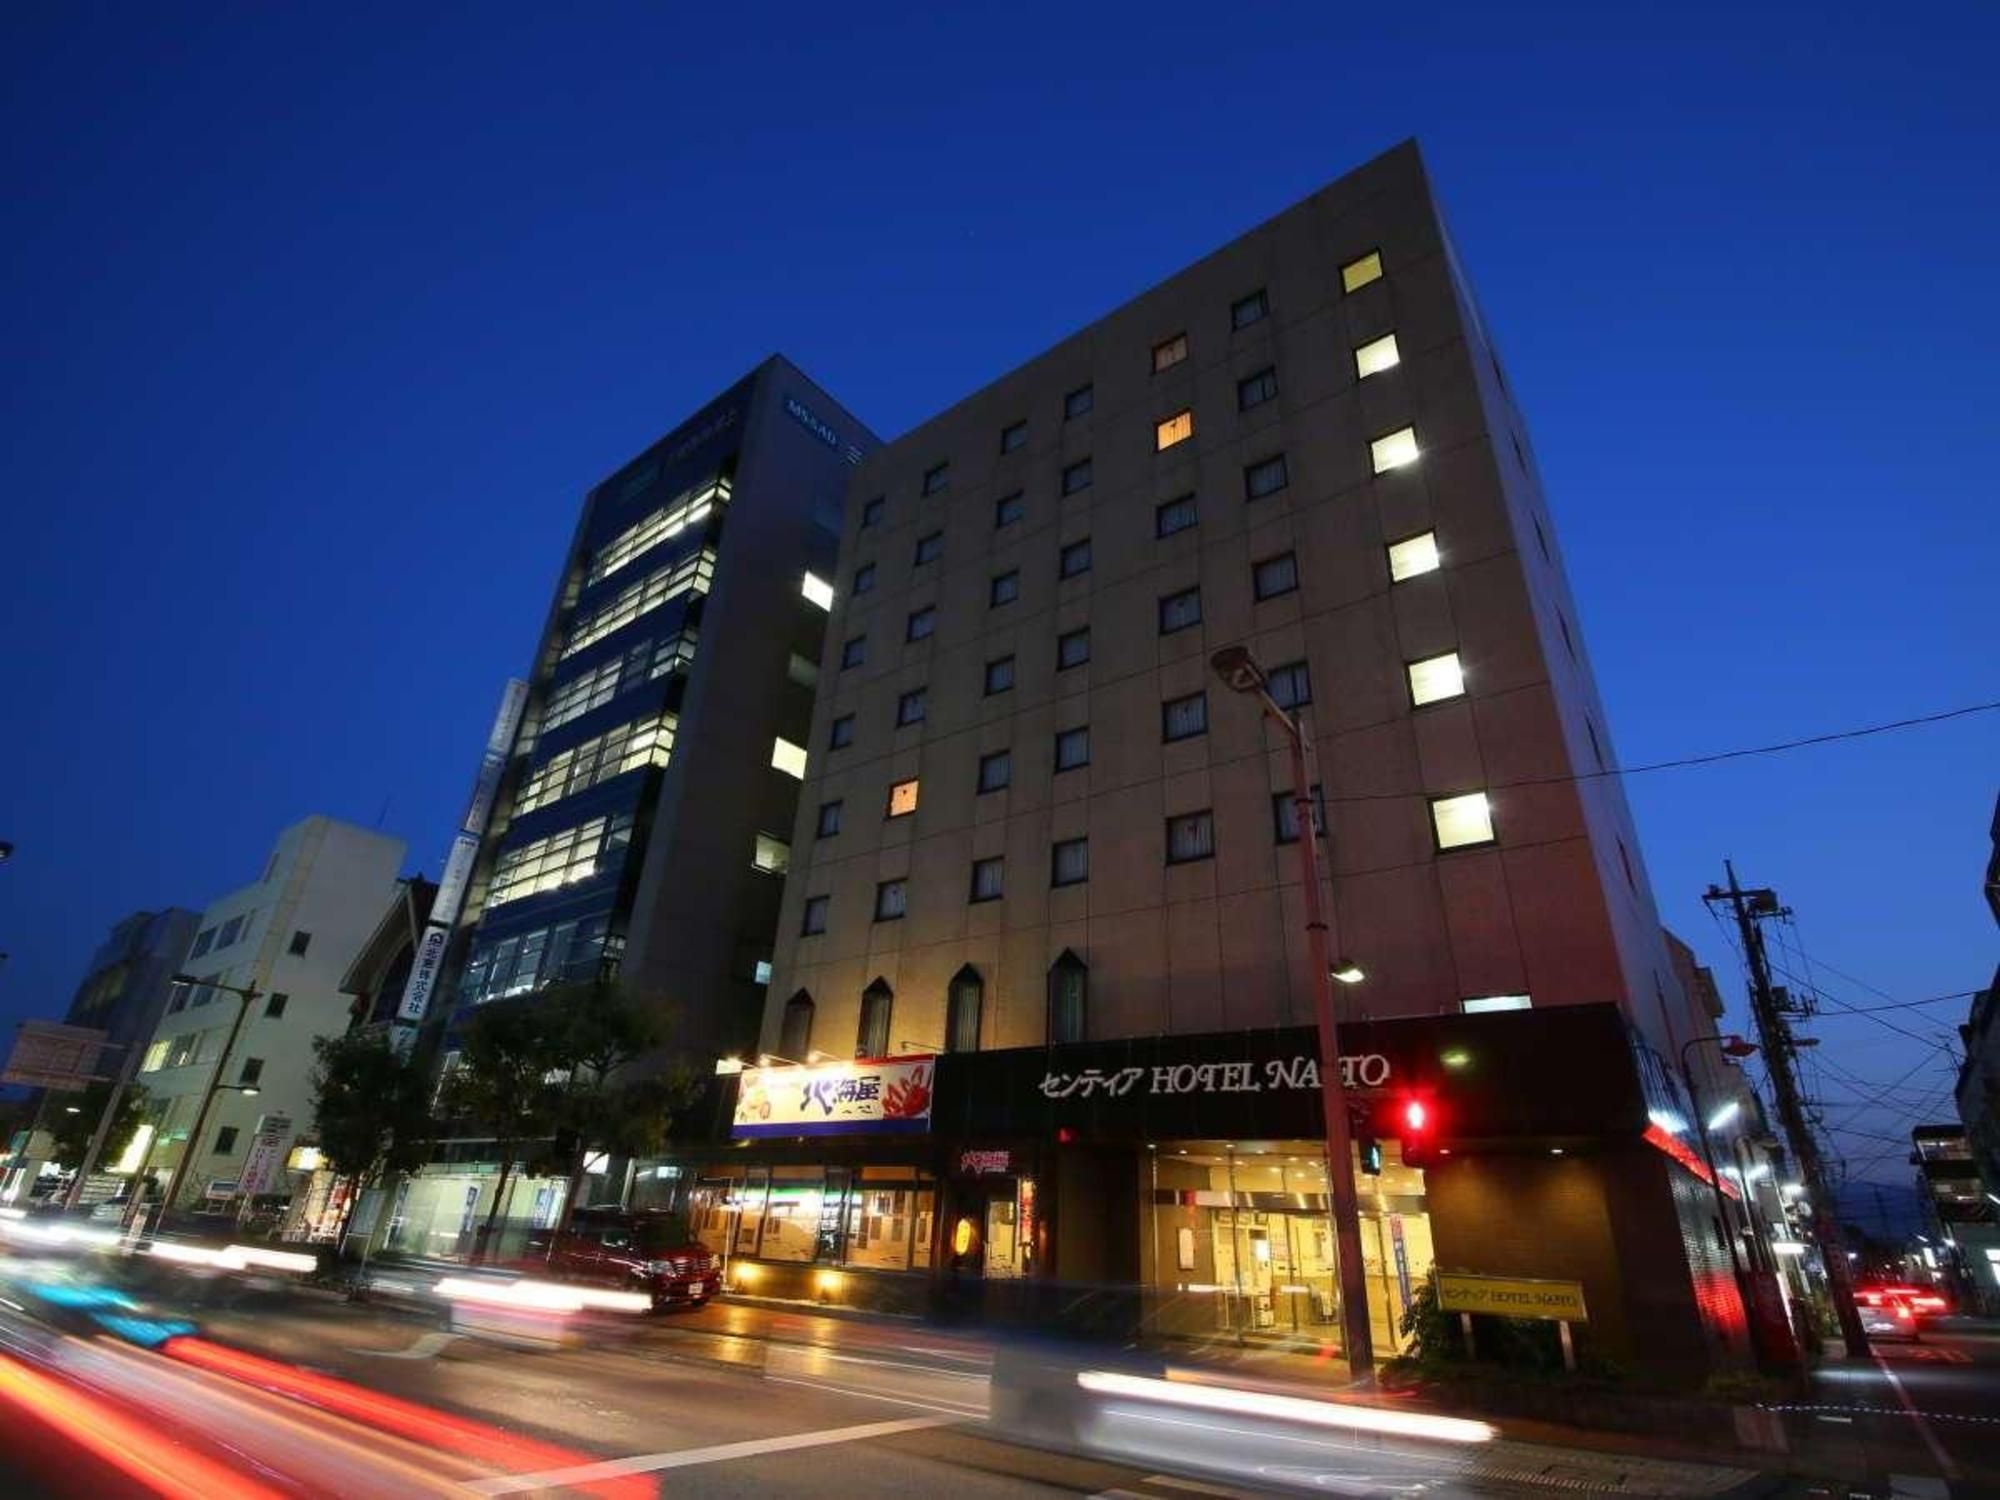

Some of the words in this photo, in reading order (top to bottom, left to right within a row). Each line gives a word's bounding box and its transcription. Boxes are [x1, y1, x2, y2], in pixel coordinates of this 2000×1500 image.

[1039, 1067, 1143, 1099] センティア
[1150, 1063, 1261, 1094] HOTEL
[1265, 1054, 1392, 1092] NATO
